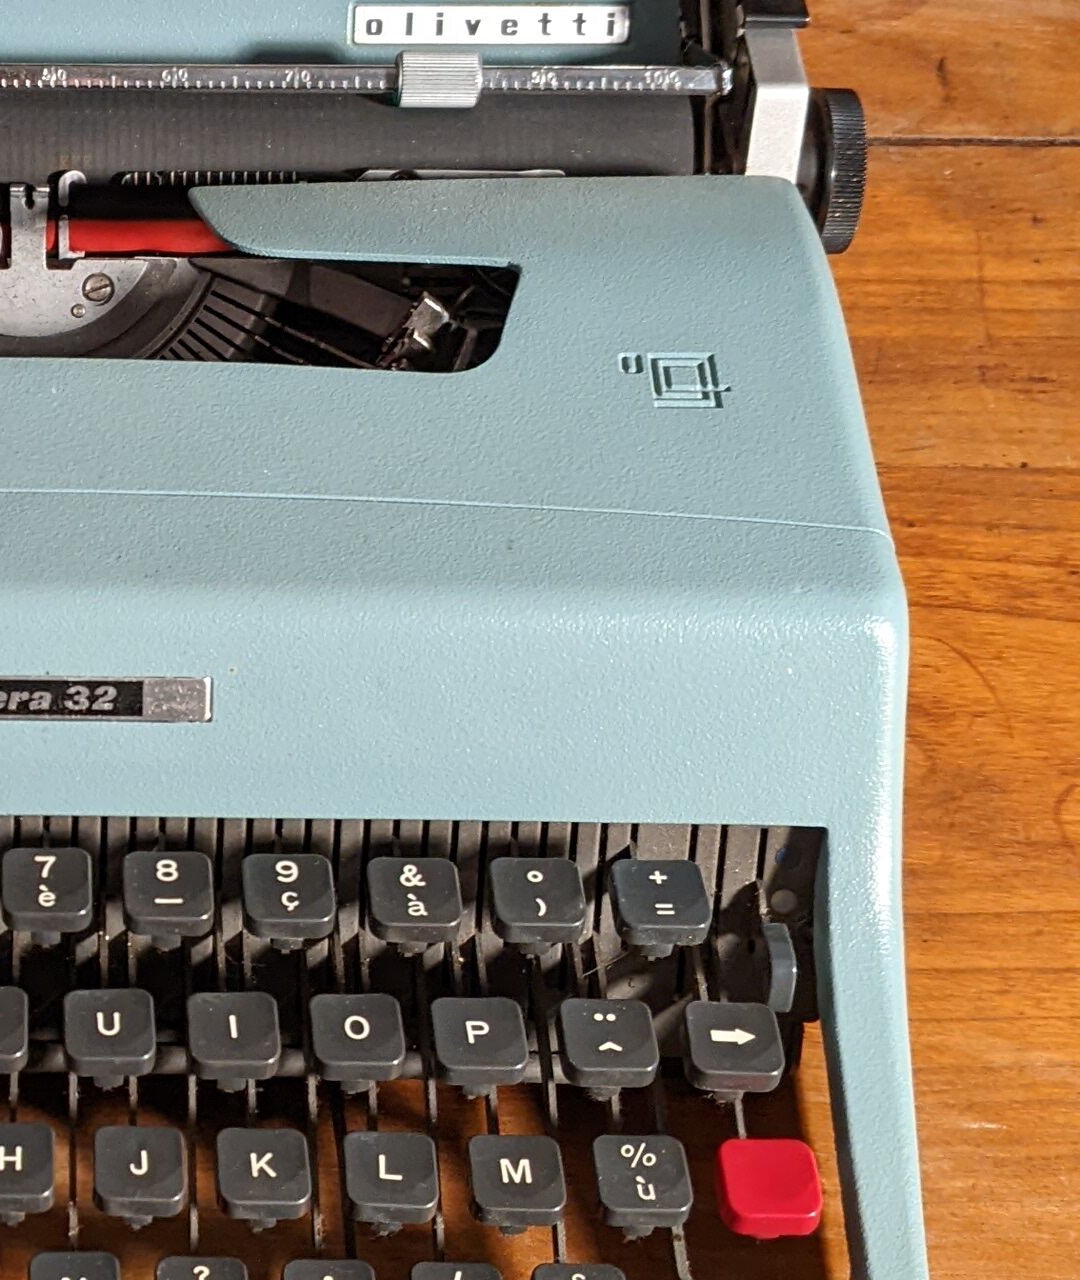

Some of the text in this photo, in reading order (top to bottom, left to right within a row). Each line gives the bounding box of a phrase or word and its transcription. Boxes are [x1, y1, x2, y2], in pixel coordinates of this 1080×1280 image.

[365, 12, 617, 37] olivetti
[63, 684, 118, 711] 32
[33, 855, 57, 878] 7
[155, 859, 180, 882] 8
[274, 860, 299, 883] 9
[398, 864, 426, 887] &
[647, 870, 669, 885] +
[37, 884, 57, 908] è
[280, 890, 300, 911] ç
[407, 892, 429, 917] à
[535, 897, 547, 918] )
[654, 902, 676, 915] =
[96, 1011, 121, 1036] U
[228, 1014, 238, 1039] I
[343, 1015, 371, 1040] O
[465, 1020, 490, 1044] P
[129, 1150, 149, 1176] J
[250, 1152, 277, 1178] K
[378, 1154, 403, 1181] L
[499, 1158, 533, 1184] M
[620, 1142, 657, 1168] %
[635, 1175, 657, 1201] ù
